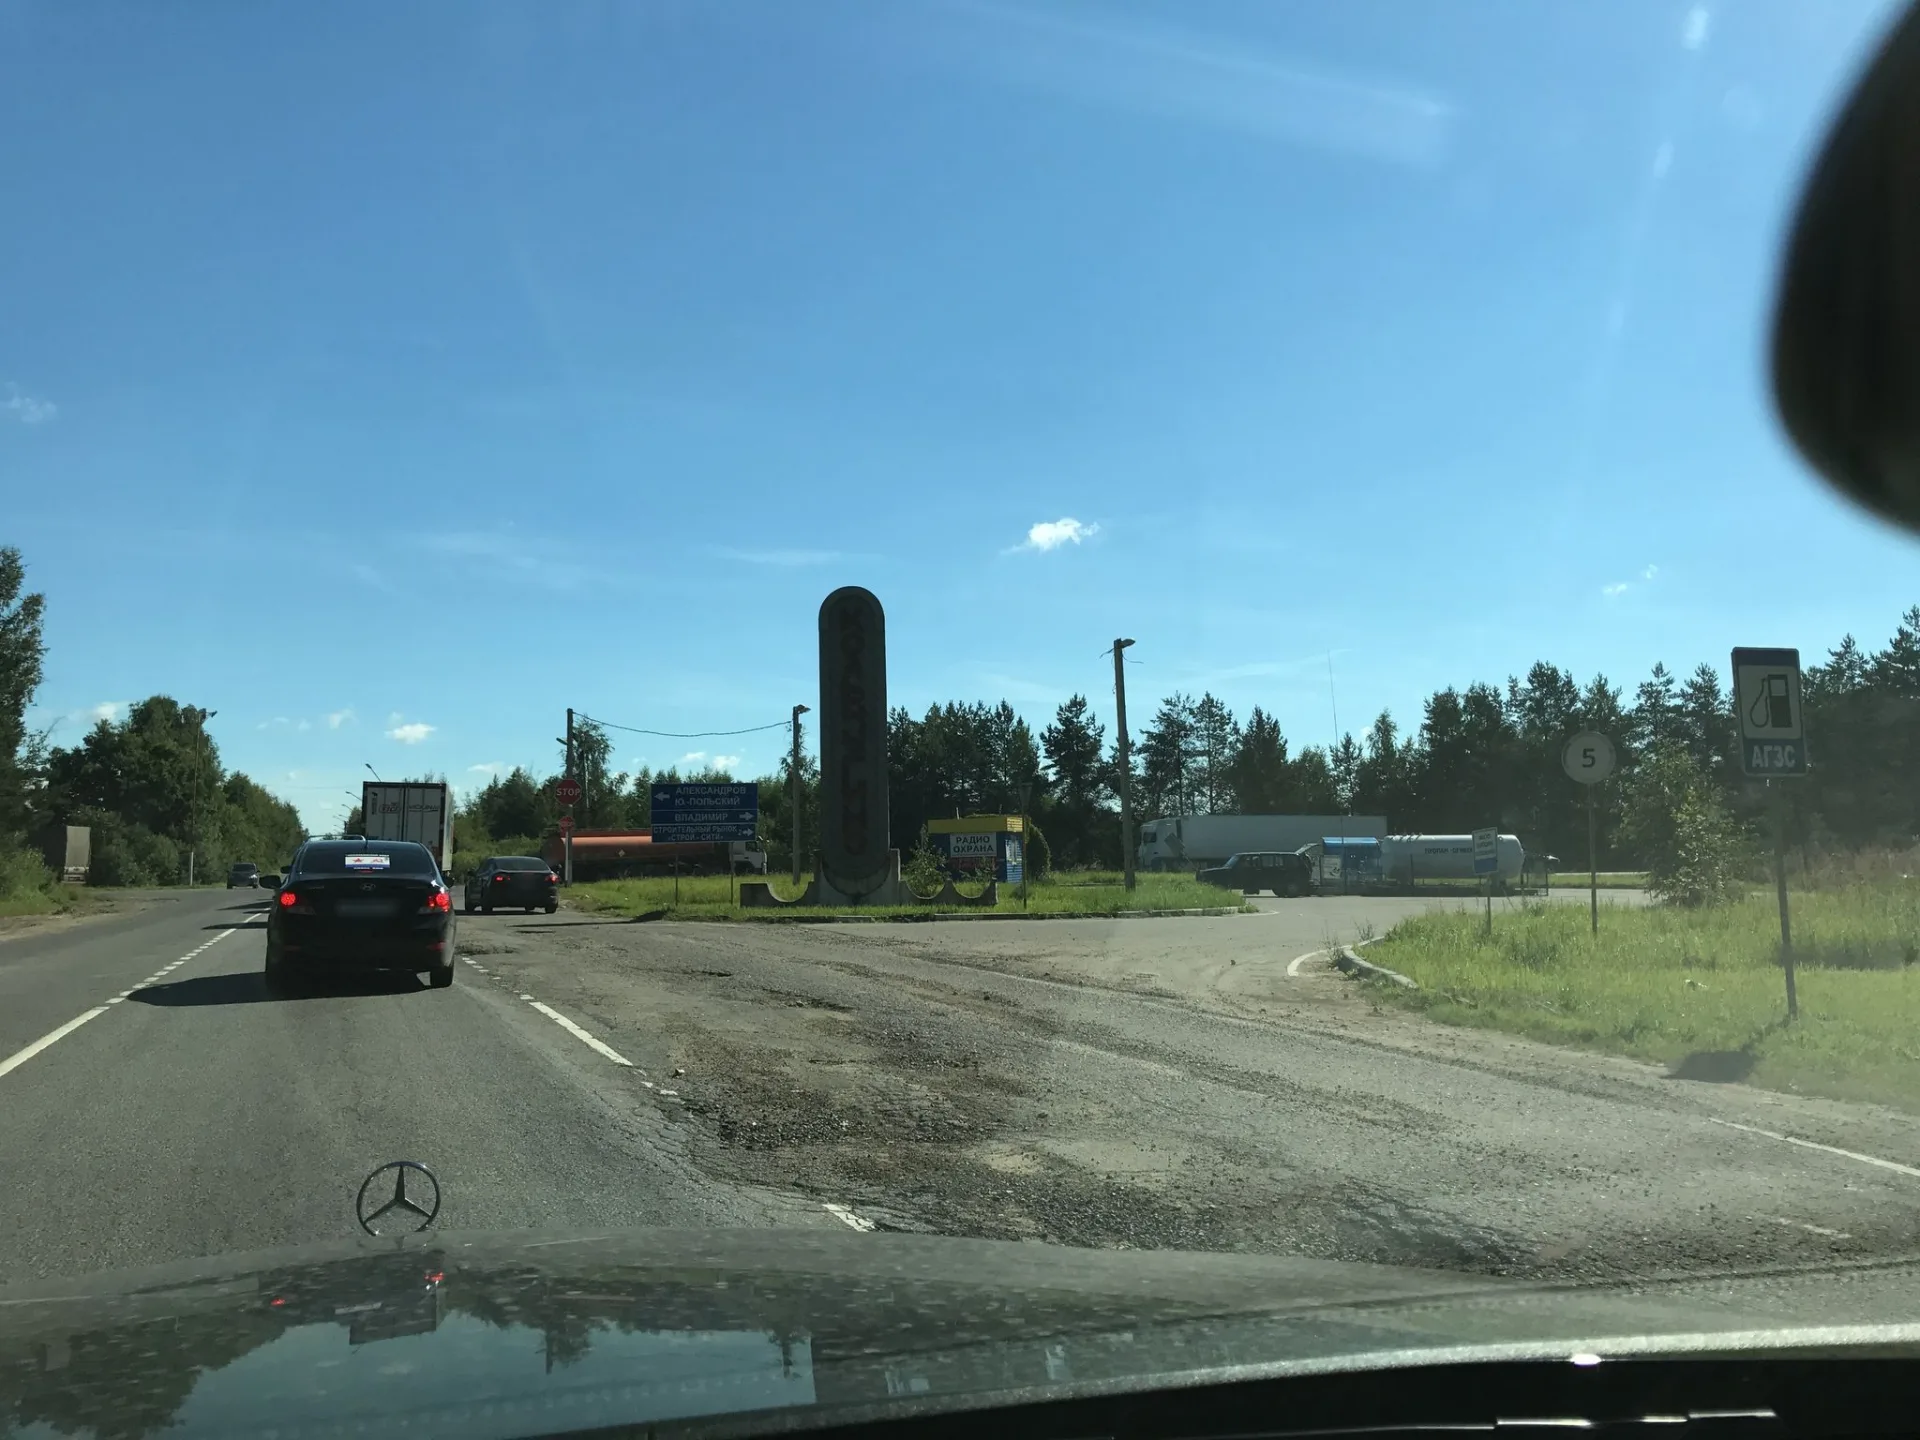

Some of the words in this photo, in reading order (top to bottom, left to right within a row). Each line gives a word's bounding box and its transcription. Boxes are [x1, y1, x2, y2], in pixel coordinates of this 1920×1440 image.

[1582, 748, 1596, 768] 5
[1752, 745, 1796, 768] АГЗС
[556, 788, 581, 796] STOP
[675, 787, 746, 795] АЛЕКСАНДРОВ
[675, 813, 728, 822] ВЛАДИМИР
[712, 825, 737, 833] РЫНОК
[956, 836, 990, 844] РАДИО
[953, 845, 994, 853] ОХРАНА
